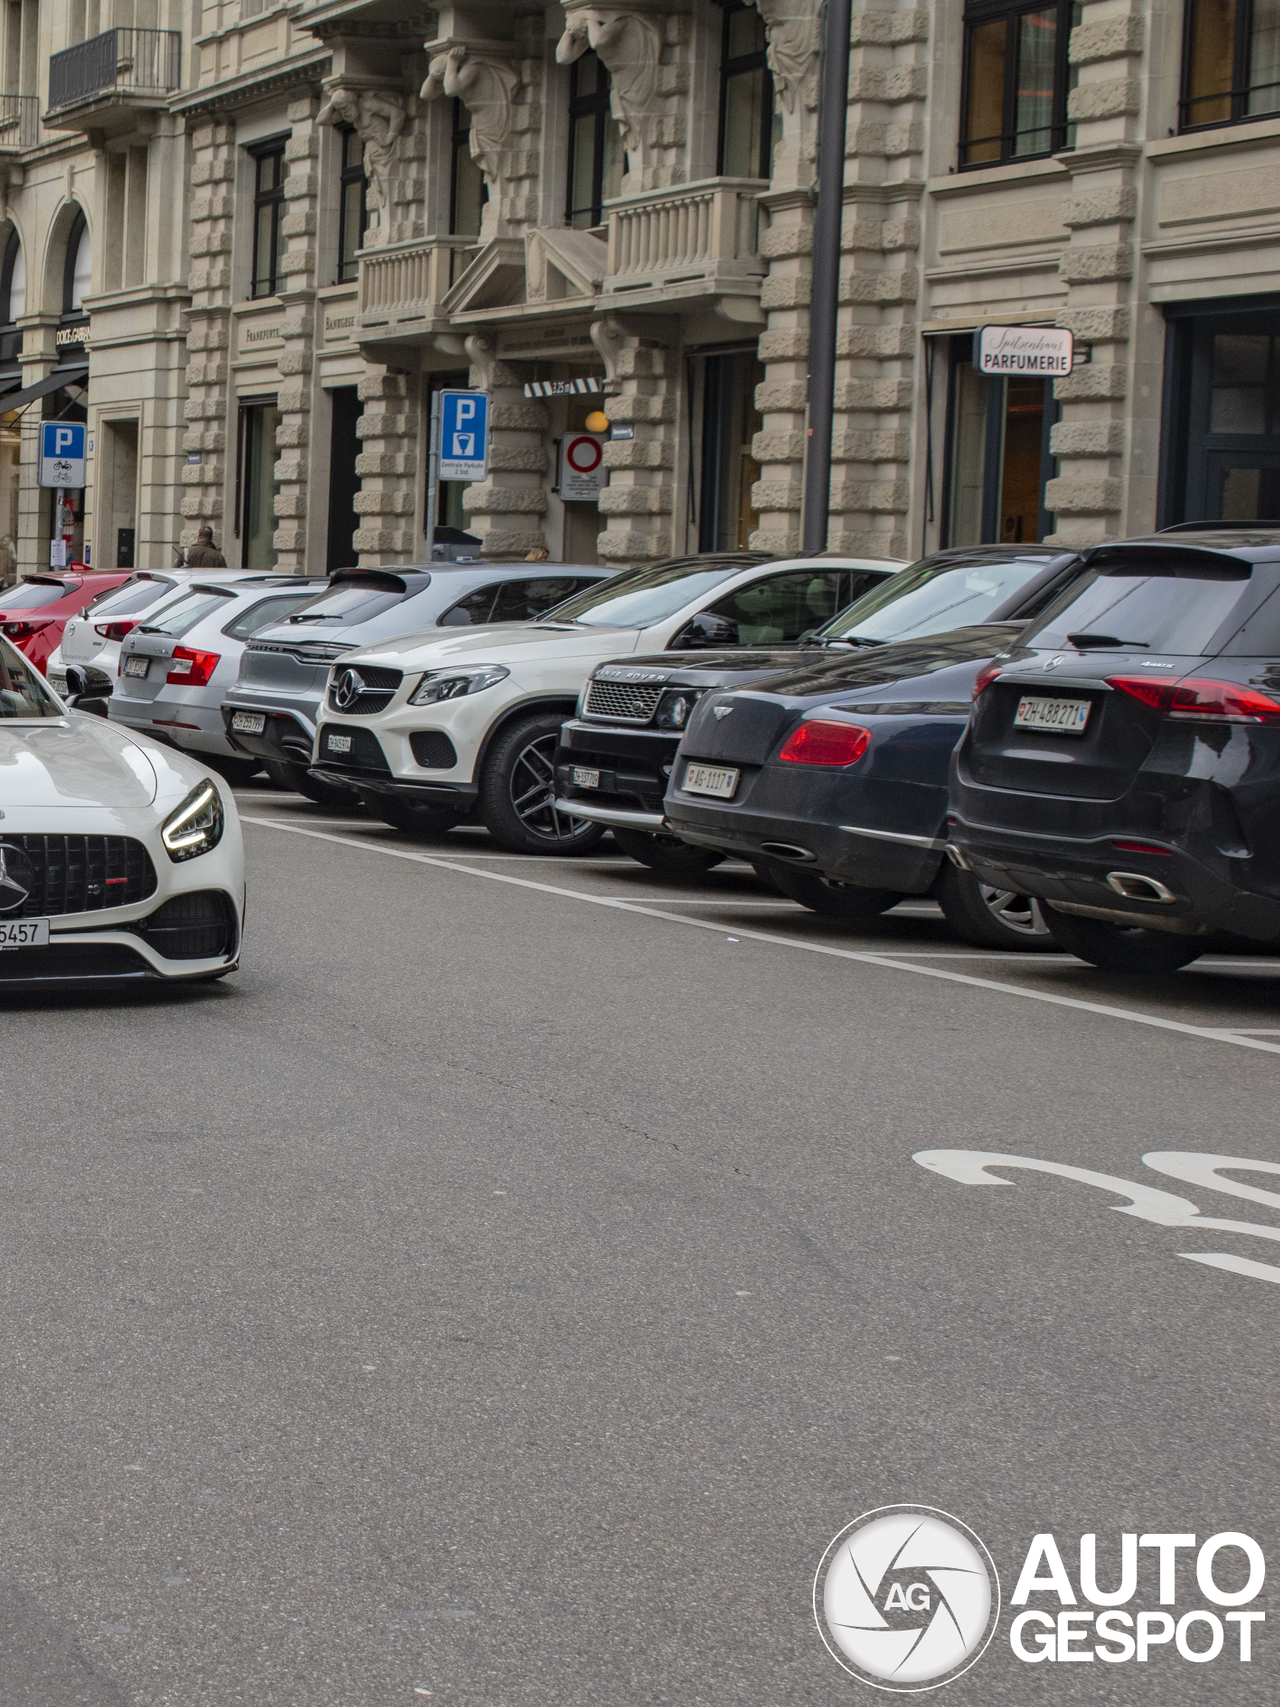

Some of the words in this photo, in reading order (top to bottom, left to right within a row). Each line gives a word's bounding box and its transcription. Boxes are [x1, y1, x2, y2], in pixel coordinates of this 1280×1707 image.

[985, 353, 1068, 371] PARFUMERIE
[457, 399, 475, 430] P
[56, 428, 73, 454] P
[626, 671, 666, 681] ROVER
